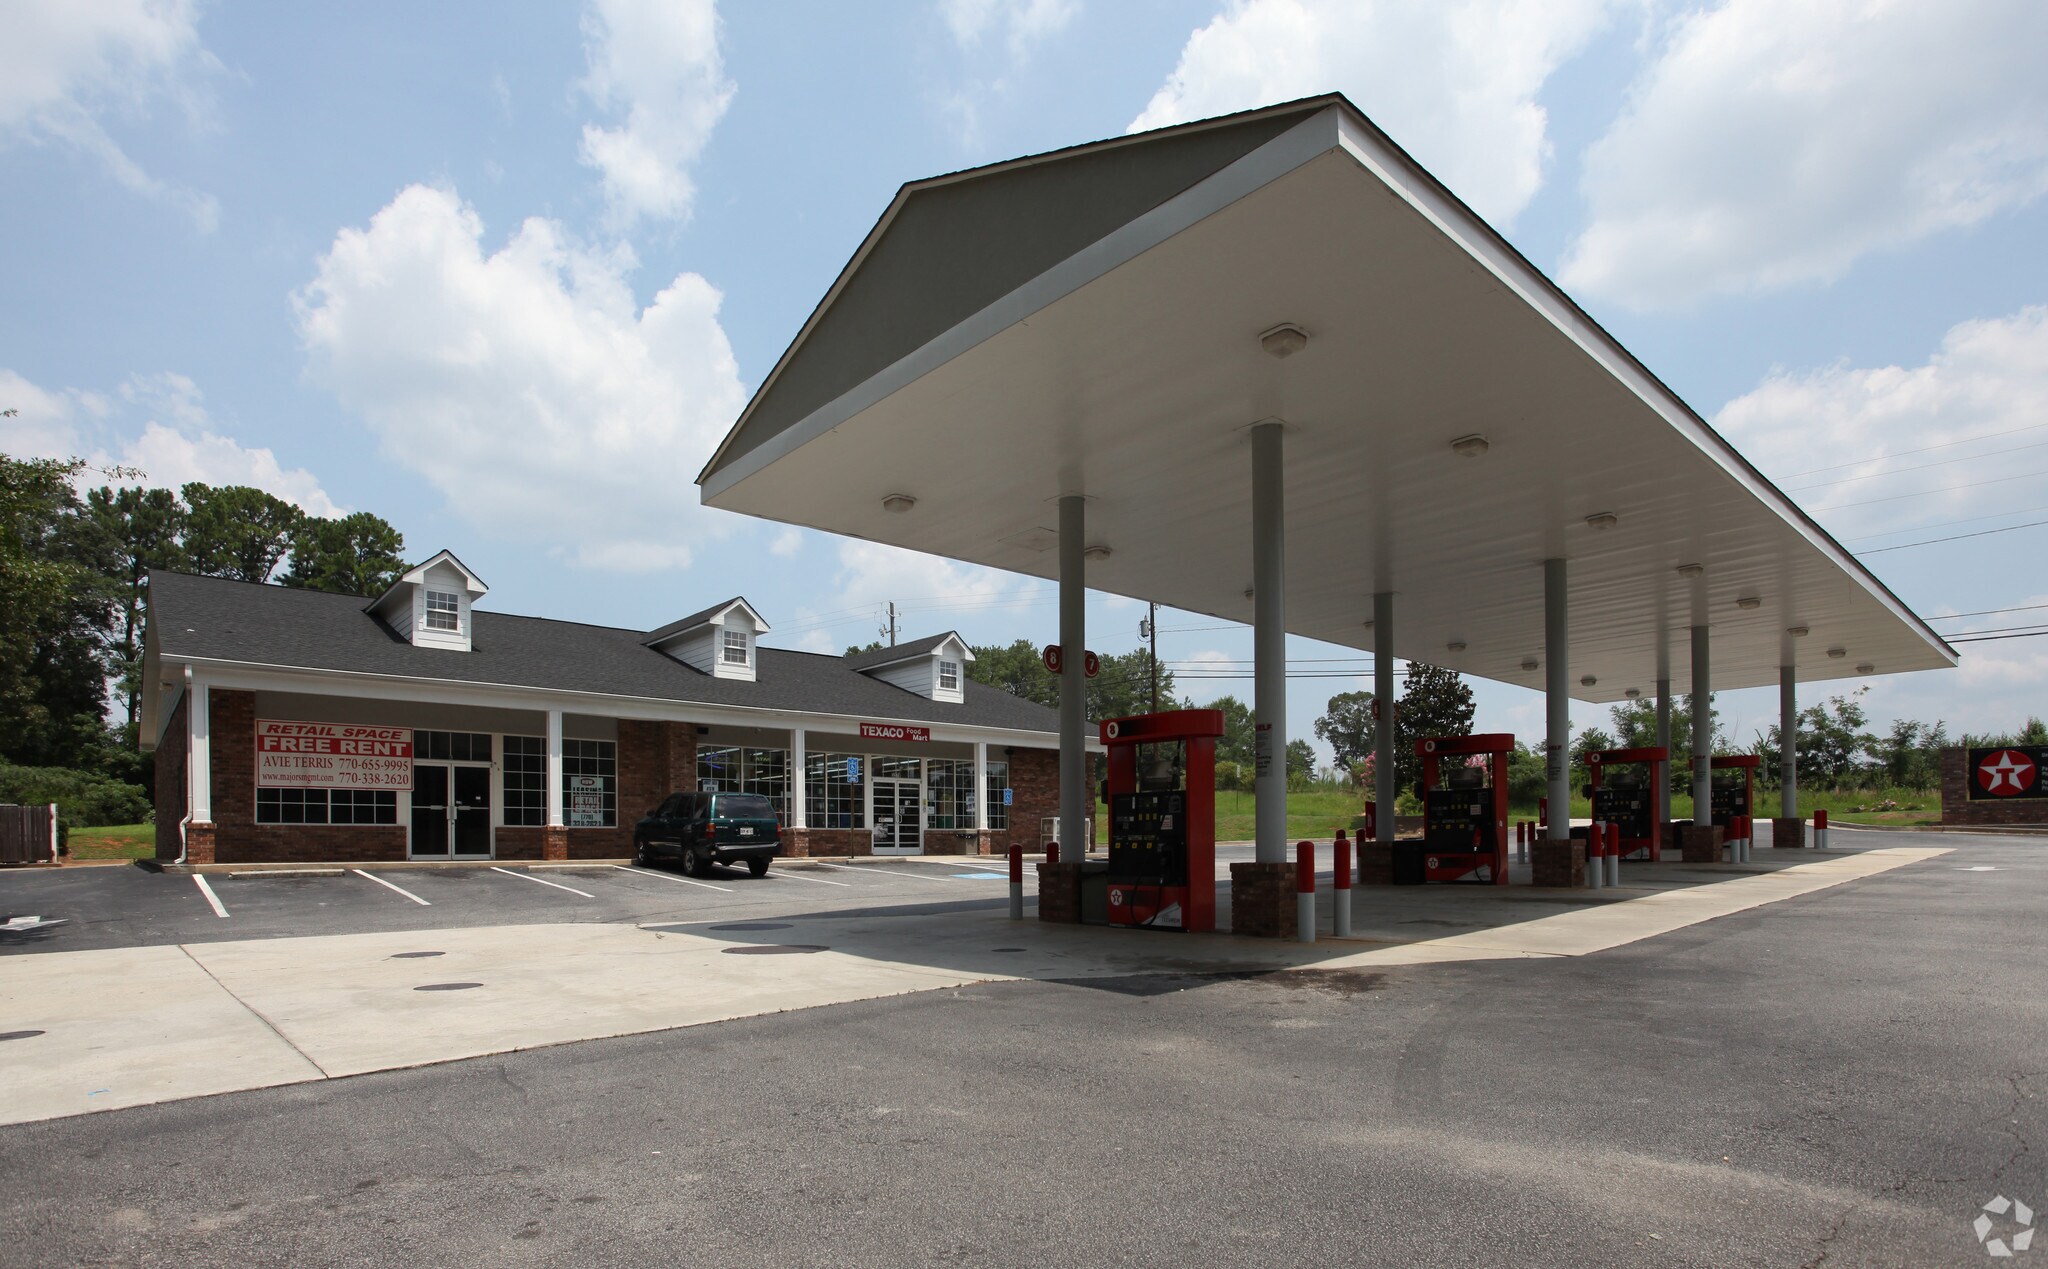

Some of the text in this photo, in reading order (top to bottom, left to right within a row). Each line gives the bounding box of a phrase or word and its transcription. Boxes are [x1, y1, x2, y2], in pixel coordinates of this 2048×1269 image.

[1050, 652, 1057, 664] 8
[1089, 659, 1095, 670] 7
[266, 724, 404, 740] RETAIL SPACE
[862, 725, 922, 738] TEXACO Food
[1109, 723, 1116, 736] 8
[263, 737, 406, 756] FREE RENT
[263, 756, 409, 772] AVIE TERRIS 770-655-9995
[262, 772, 409, 785] www.majorsmgmt.com 770-338-2620
